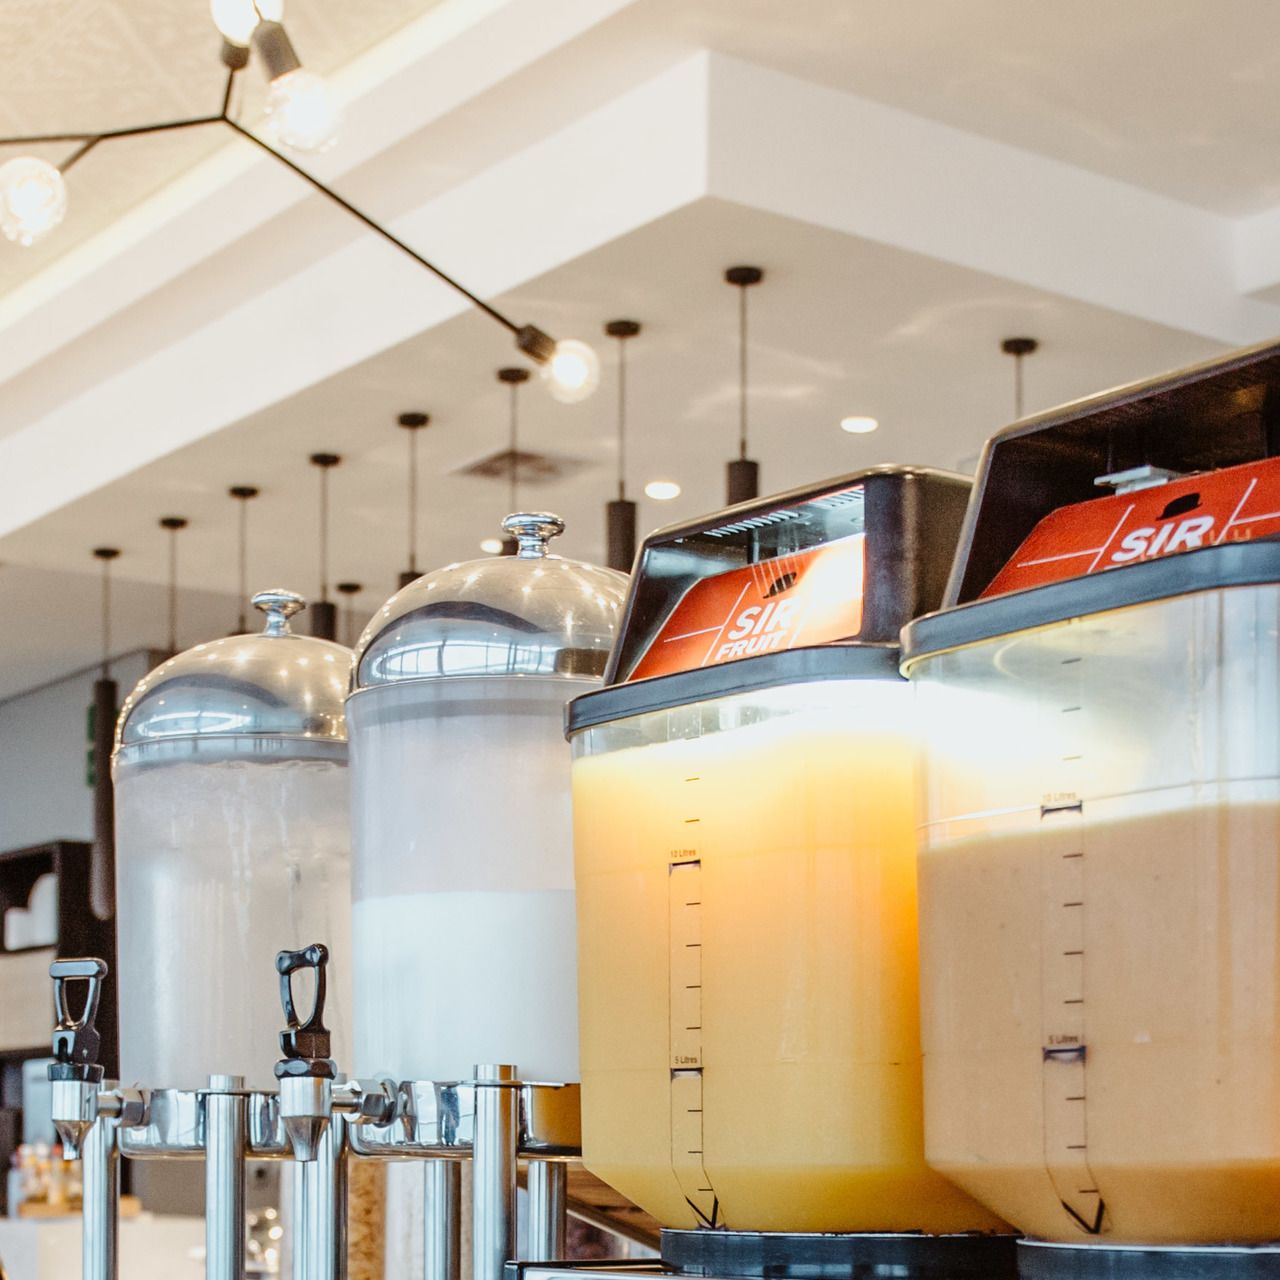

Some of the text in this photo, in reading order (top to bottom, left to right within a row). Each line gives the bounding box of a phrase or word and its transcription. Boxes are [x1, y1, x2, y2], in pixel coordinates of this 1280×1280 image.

[1111, 516, 1215, 562] SIR
[727, 596, 802, 642] SIR
[714, 630, 787, 662] FRUIT
[680, 1055, 697, 1064] Litres
